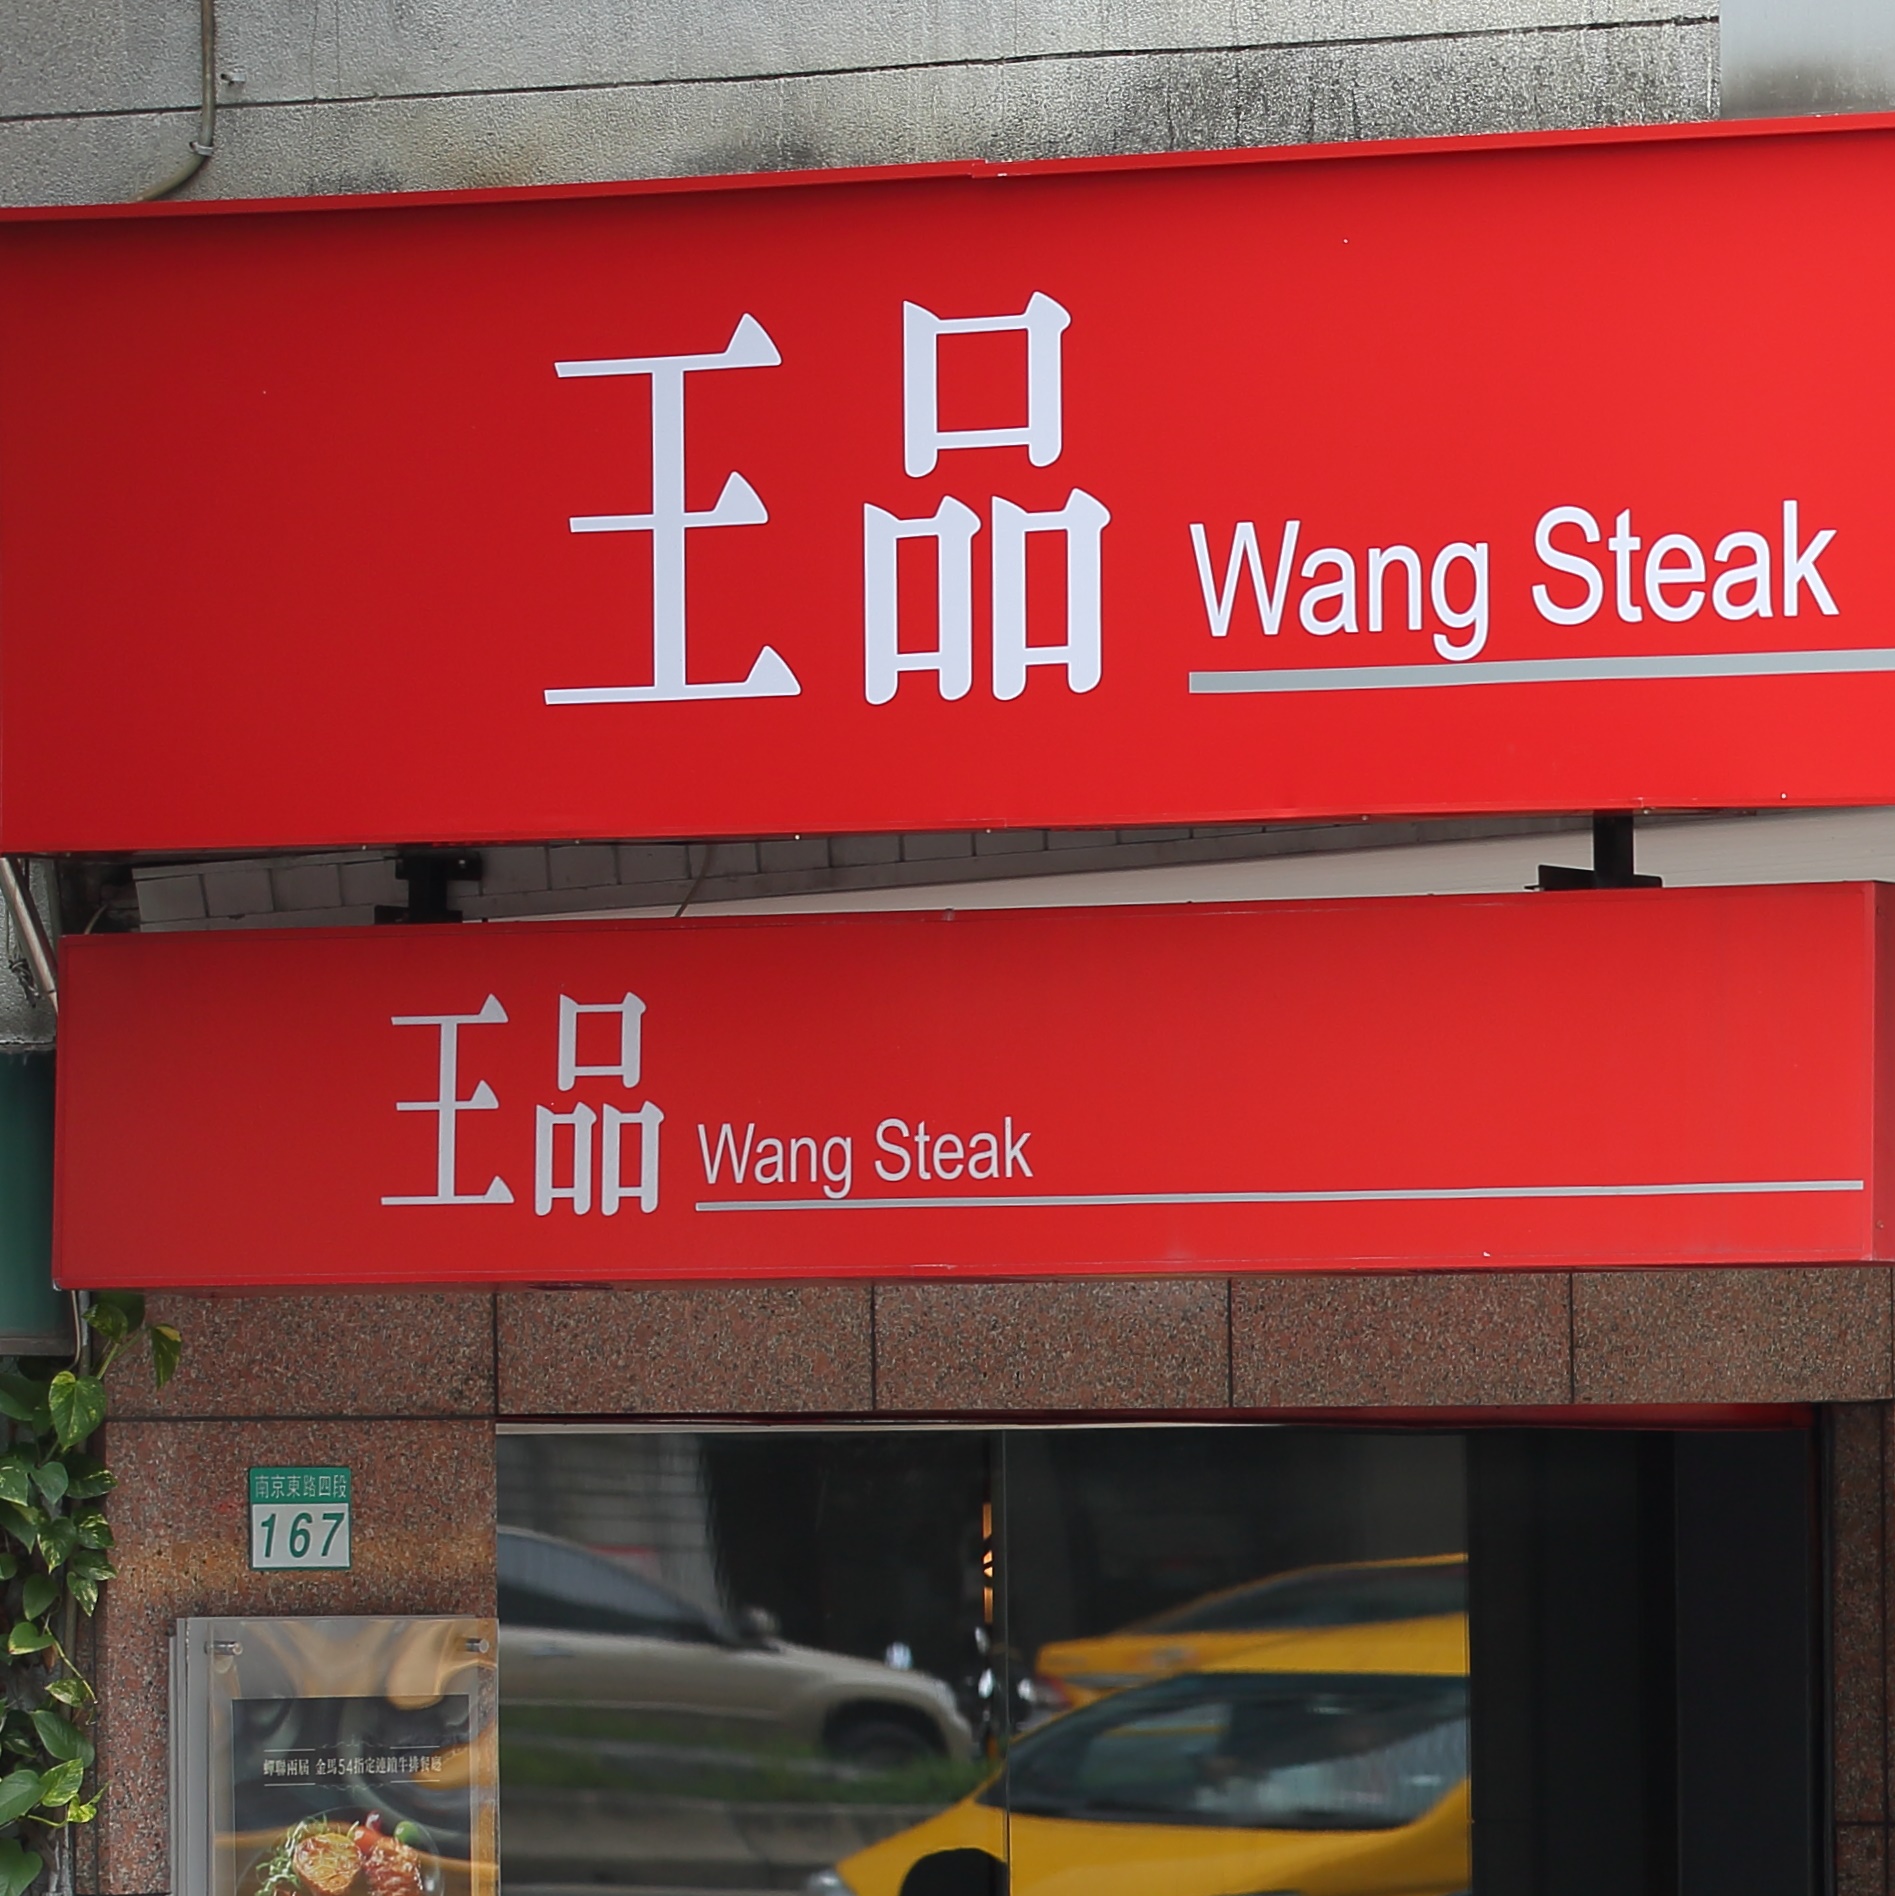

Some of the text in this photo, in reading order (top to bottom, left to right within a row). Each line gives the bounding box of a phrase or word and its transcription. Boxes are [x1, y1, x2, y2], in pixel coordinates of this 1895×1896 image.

[543, 291, 1840, 706] 王品 Wang Steak
[380, 992, 1034, 1216] 王品 Wang Steak
[255, 1474, 348, 1499] 南京東路四段
[261, 1512, 345, 1559] 167
